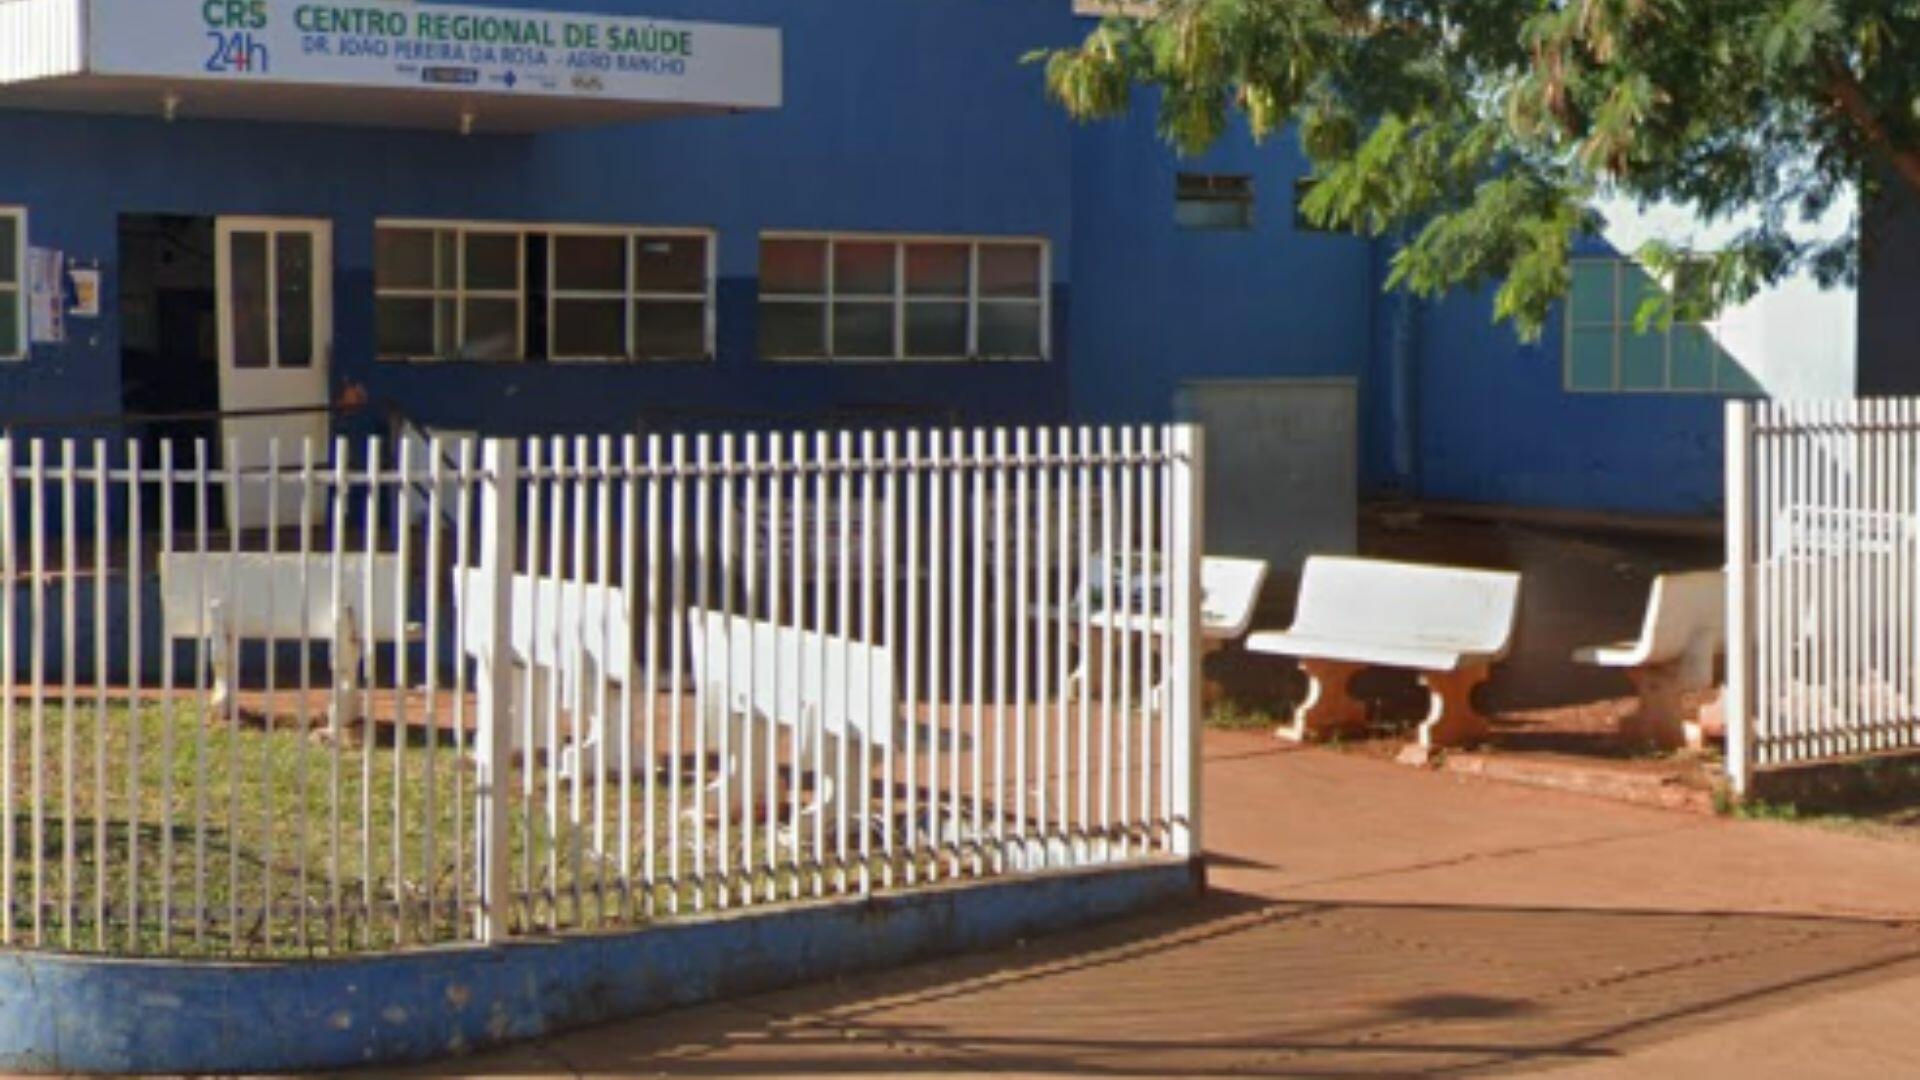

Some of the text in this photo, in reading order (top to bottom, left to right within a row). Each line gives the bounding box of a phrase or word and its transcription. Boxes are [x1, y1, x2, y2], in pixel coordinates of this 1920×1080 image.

[203, 0, 268, 29] CRS
[294, 4, 693, 56] CENTRO REGIONAL DE SAÚDE
[205, 31, 269, 72] 24h
[394, 40, 465, 62] PEREIRA
[471, 44, 497, 64] DA
[500, 46, 549, 66] ROSA
[566, 51, 611, 72] AERO
[617, 54, 686, 76] RANCHO
